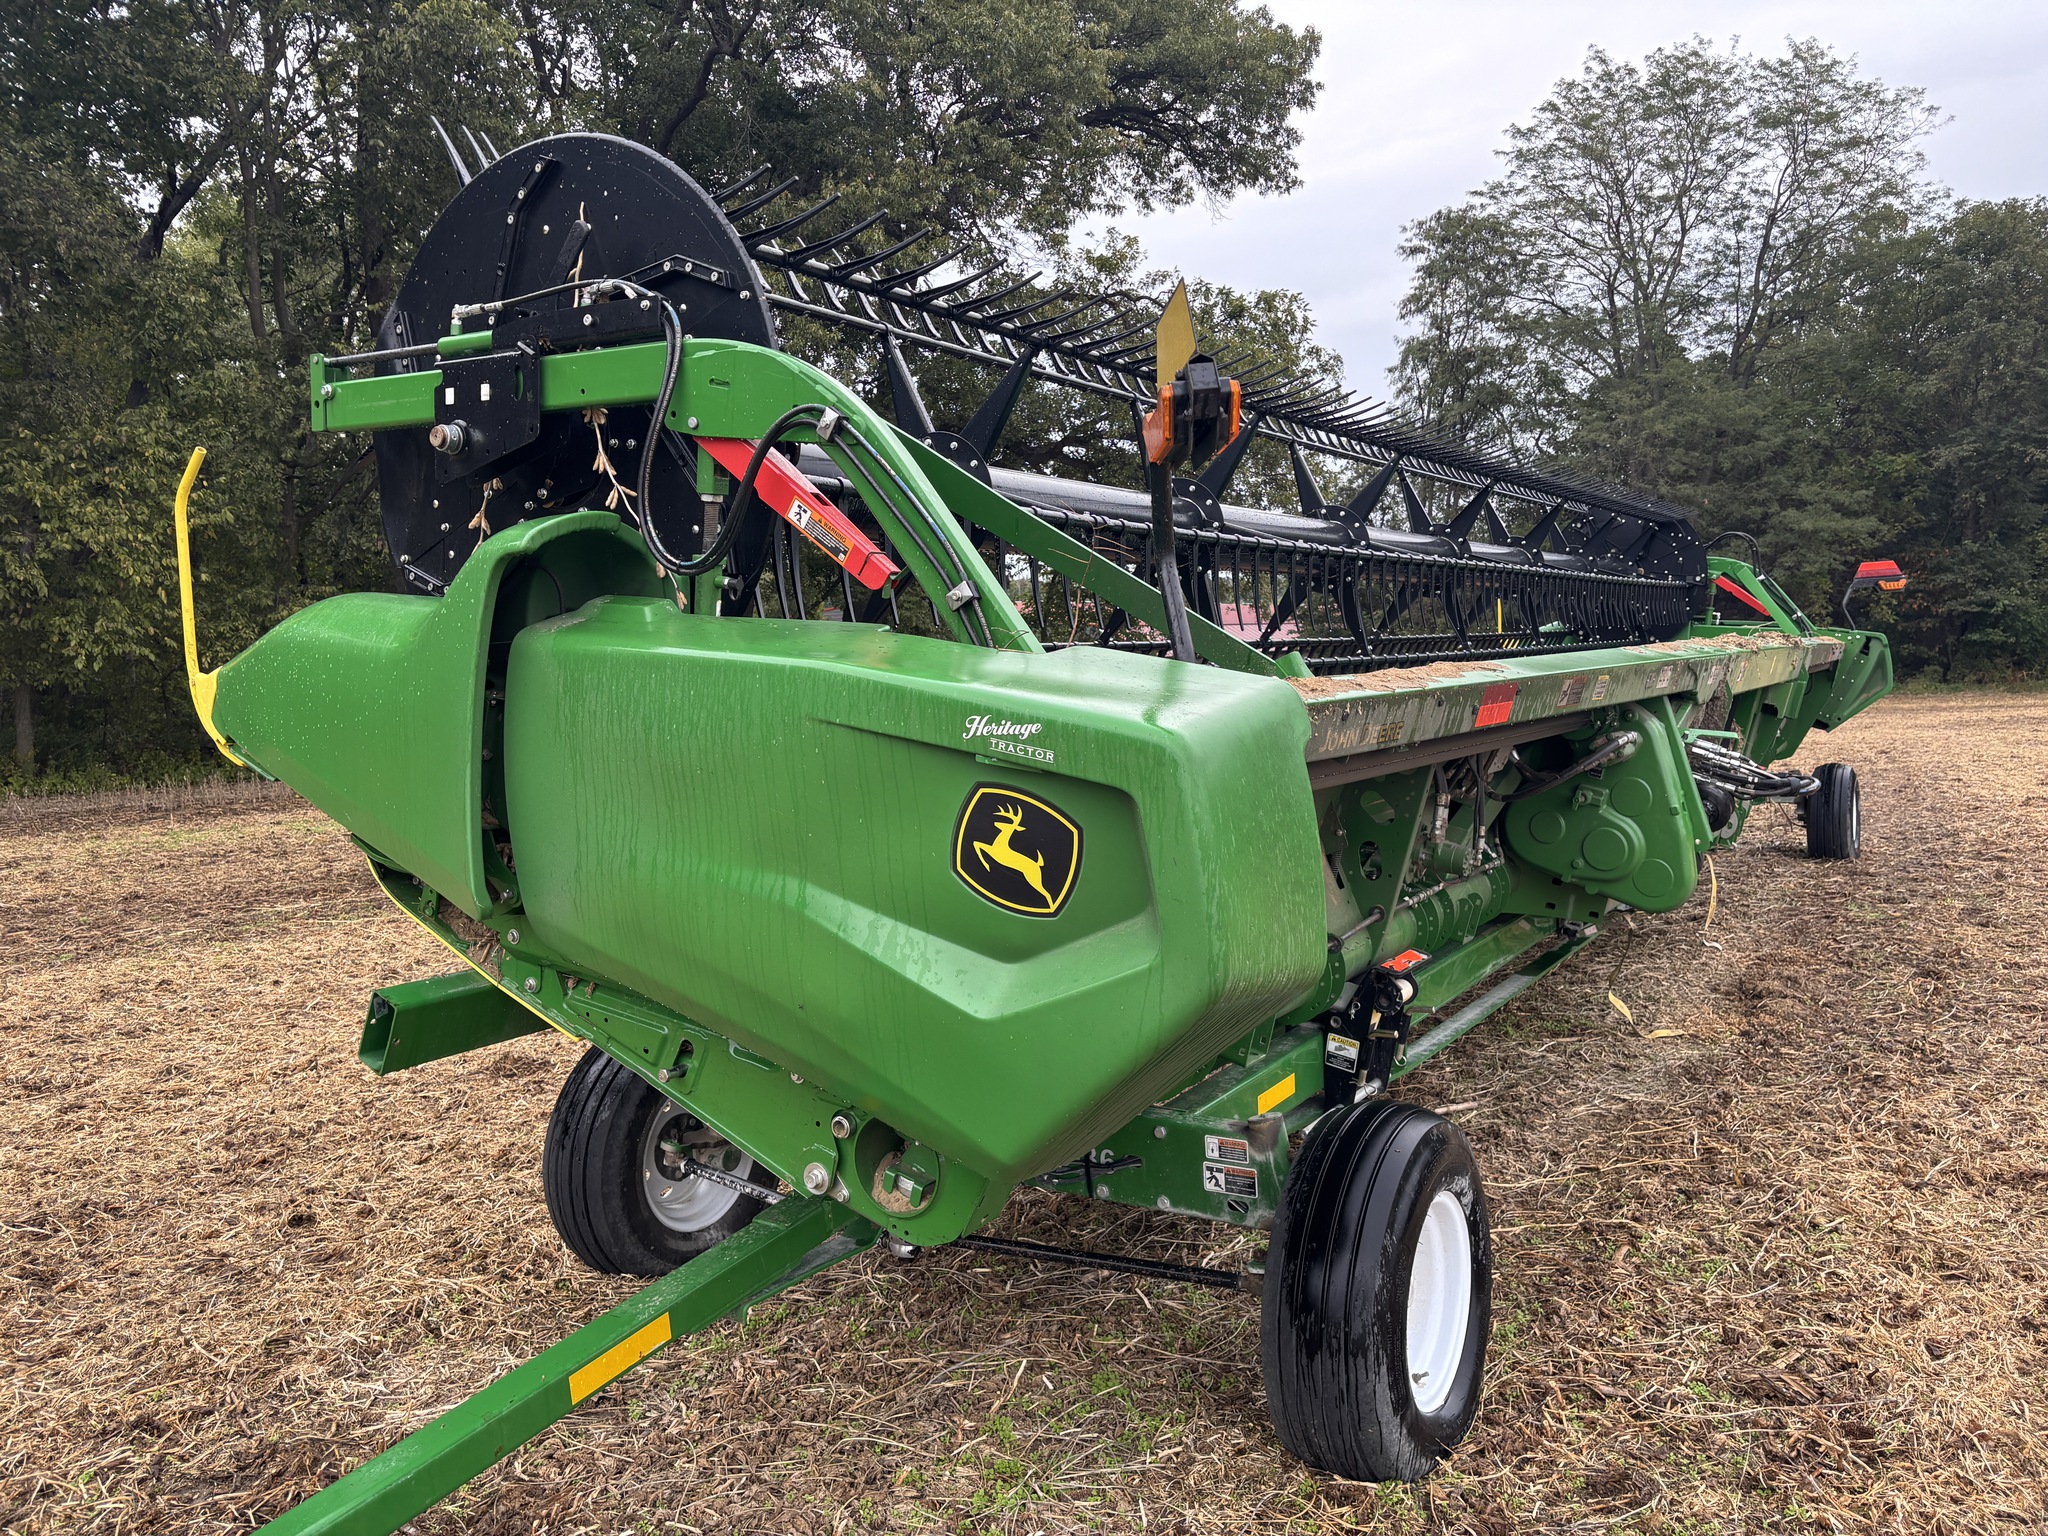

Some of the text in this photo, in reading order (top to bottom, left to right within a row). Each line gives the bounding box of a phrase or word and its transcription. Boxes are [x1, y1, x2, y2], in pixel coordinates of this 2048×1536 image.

[823, 522, 847, 543] WARNING
[962, 714, 1043, 740] Heritage
[1359, 721, 1406, 746] DEERE
[990, 739, 1055, 761] TRACTOR
